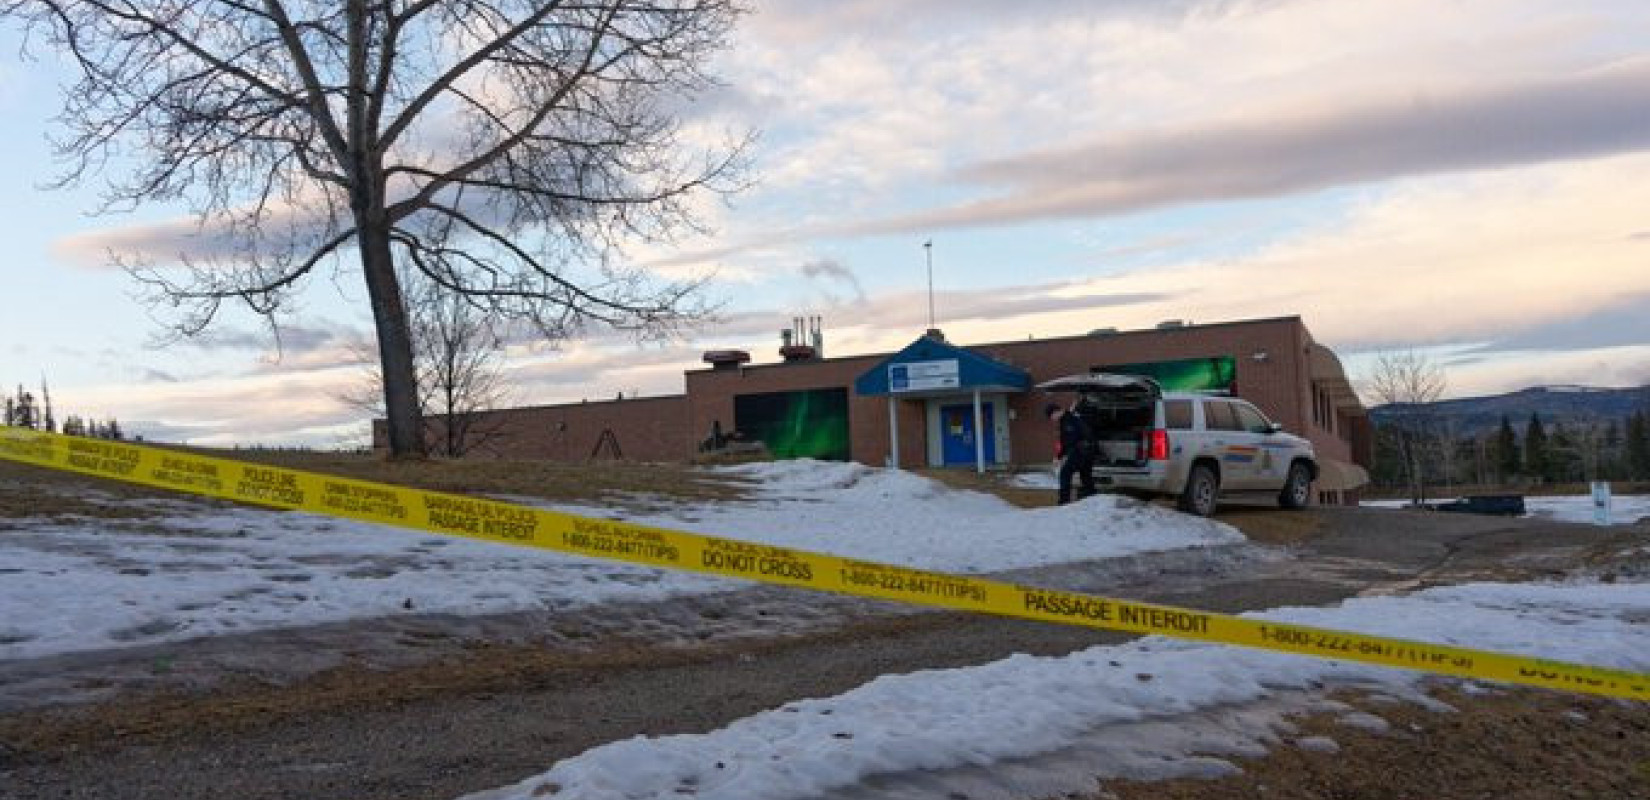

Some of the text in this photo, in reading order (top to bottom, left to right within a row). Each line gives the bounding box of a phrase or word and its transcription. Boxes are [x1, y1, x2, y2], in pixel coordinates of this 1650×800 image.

[702, 549, 814, 581] DO NOT CROSS
[1024, 591, 1211, 634] PASSAGE INTERDIT
